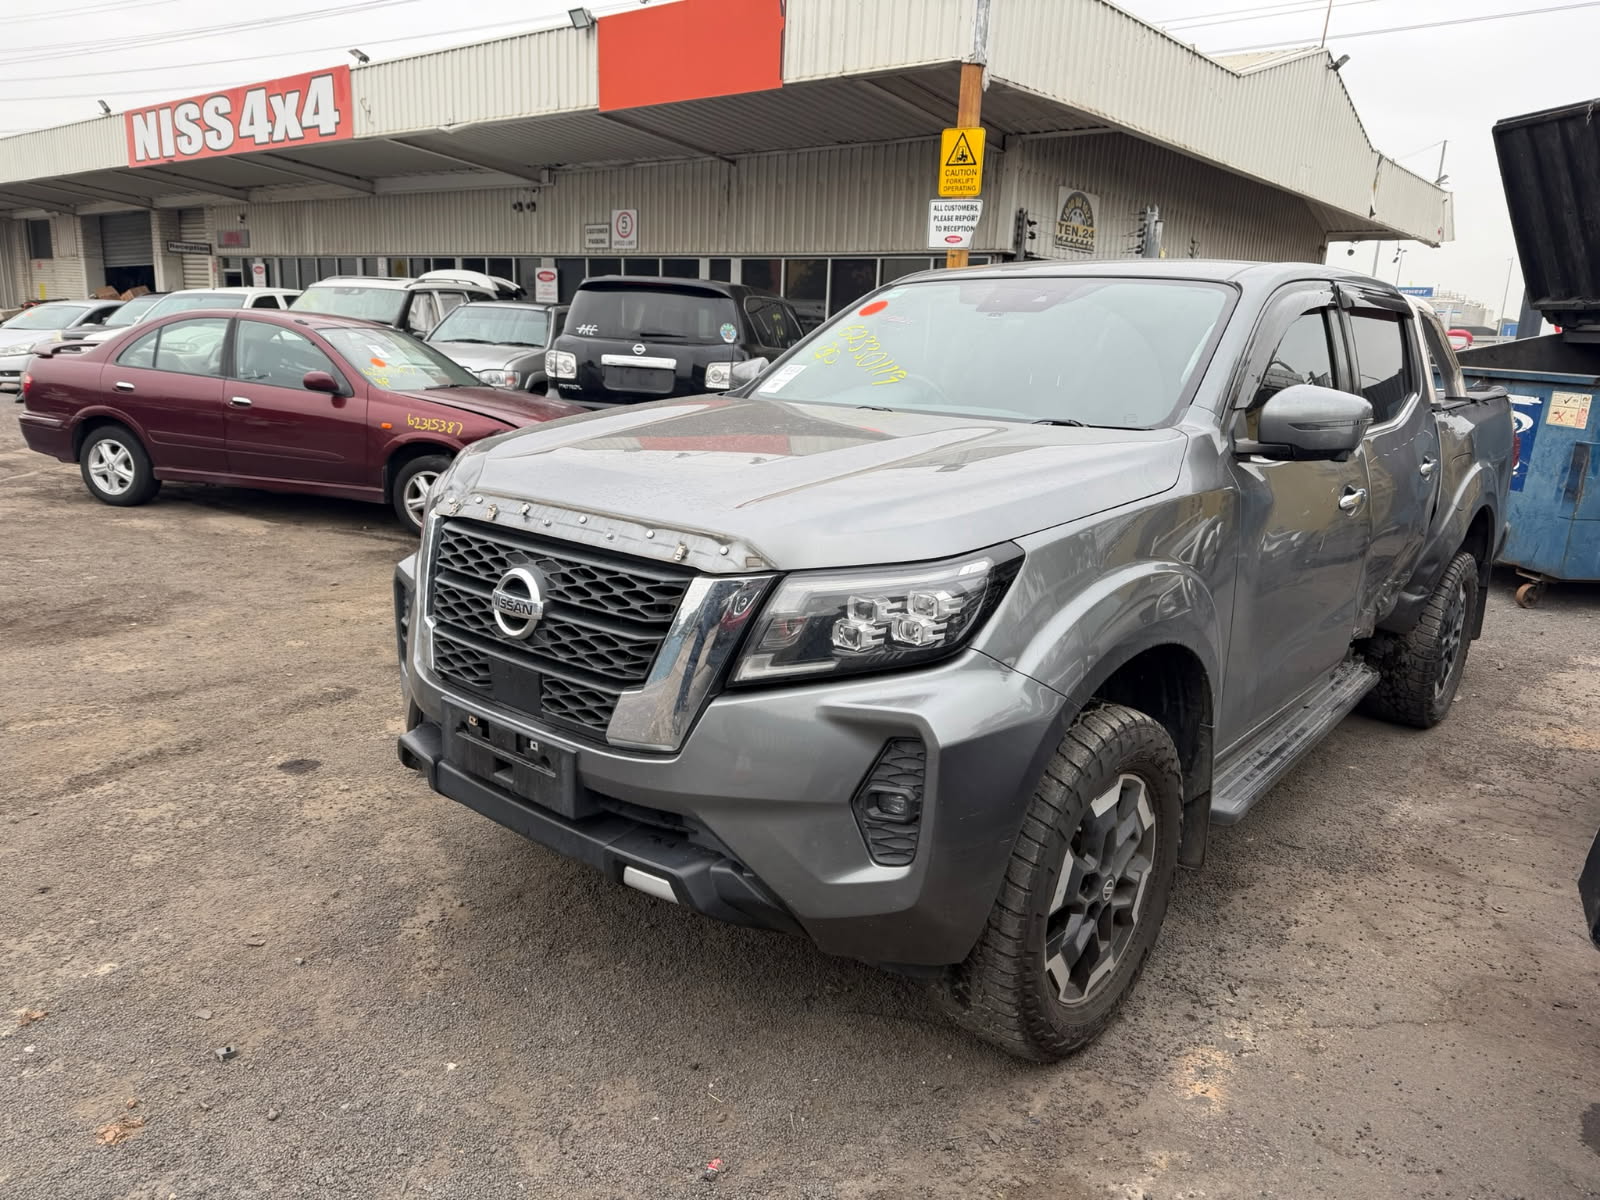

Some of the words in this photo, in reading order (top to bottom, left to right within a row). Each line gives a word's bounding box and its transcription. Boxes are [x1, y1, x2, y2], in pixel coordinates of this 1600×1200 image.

[131, 96, 234, 162] NISS
[238, 73, 340, 145] 4x4
[945, 169, 977, 177] CAUTION
[621, 216, 628, 230] 5
[407, 413, 463, 436] 62315387
[493, 593, 533, 616] NISSAN
